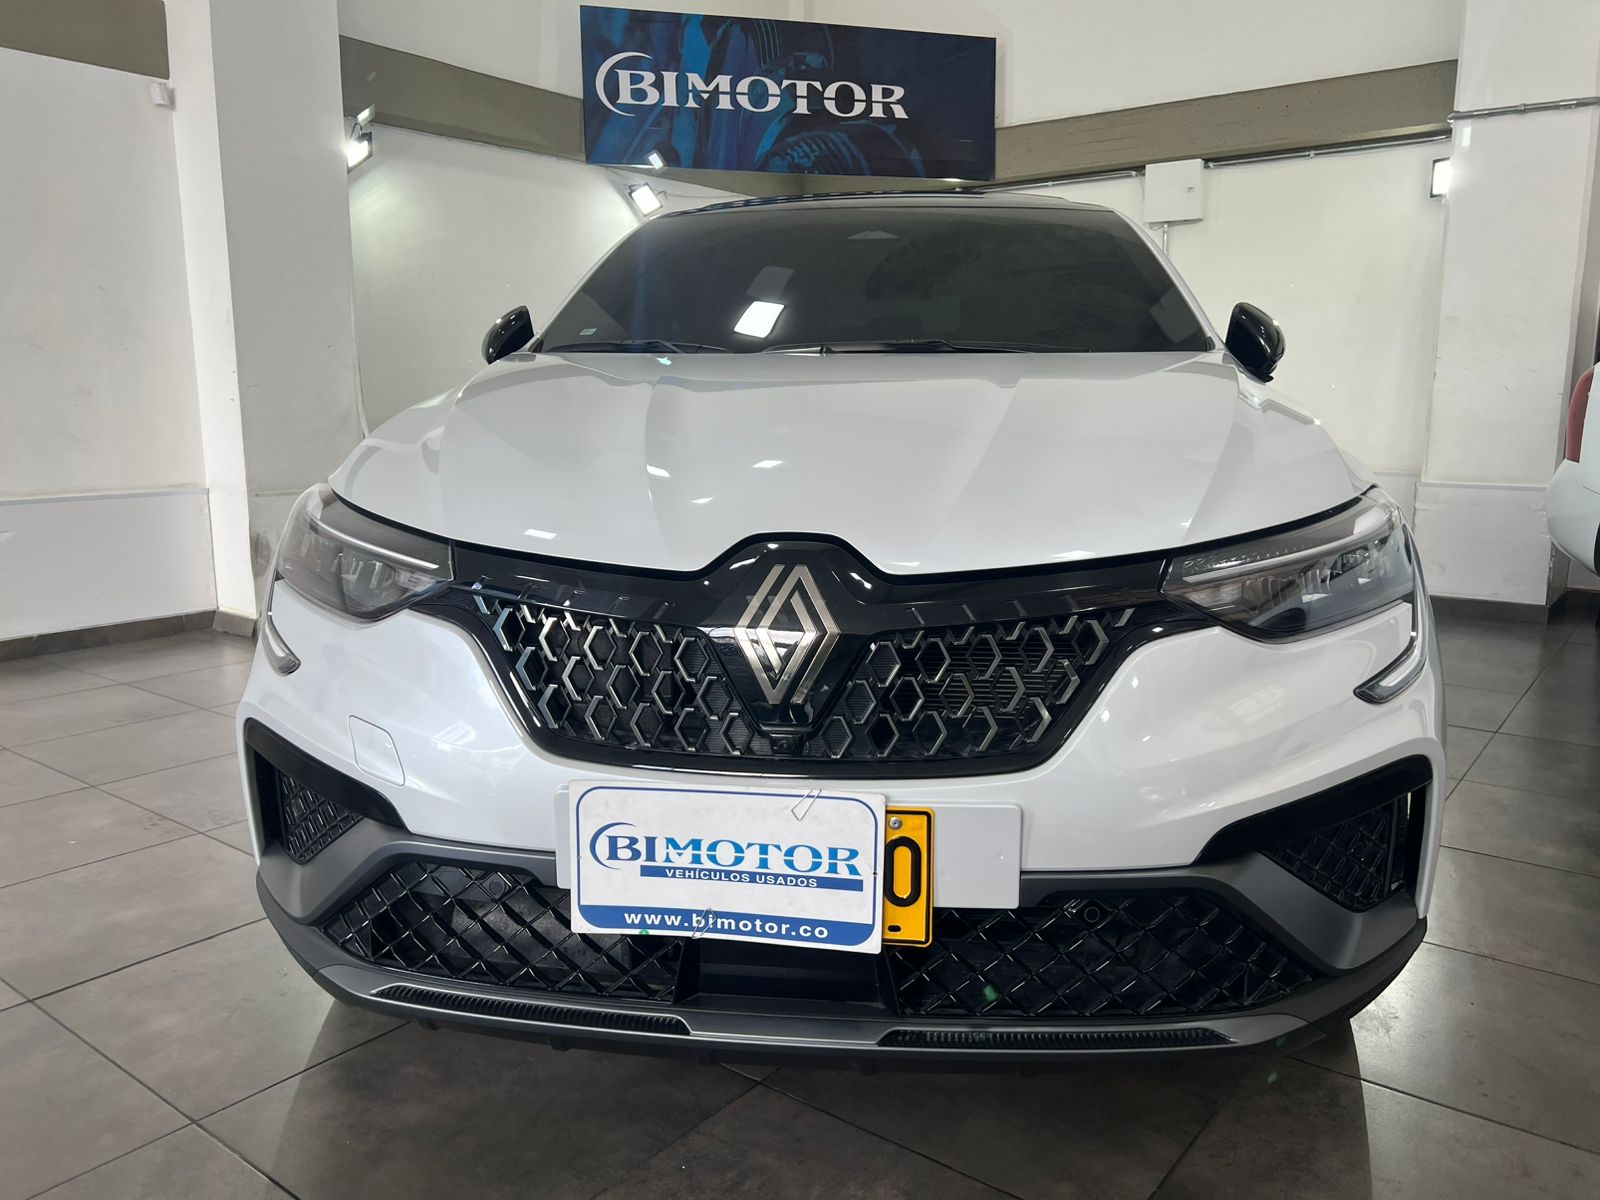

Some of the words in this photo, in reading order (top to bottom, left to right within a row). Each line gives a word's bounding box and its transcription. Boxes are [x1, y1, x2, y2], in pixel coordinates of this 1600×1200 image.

[614, 68, 909, 120] BIMOTOR
[605, 834, 863, 877] BIMOTOR
[665, 868, 751, 884] VEHÍCULOS
[755, 872, 818, 887] USADOS
[624, 911, 829, 939] www.bimotor.co
